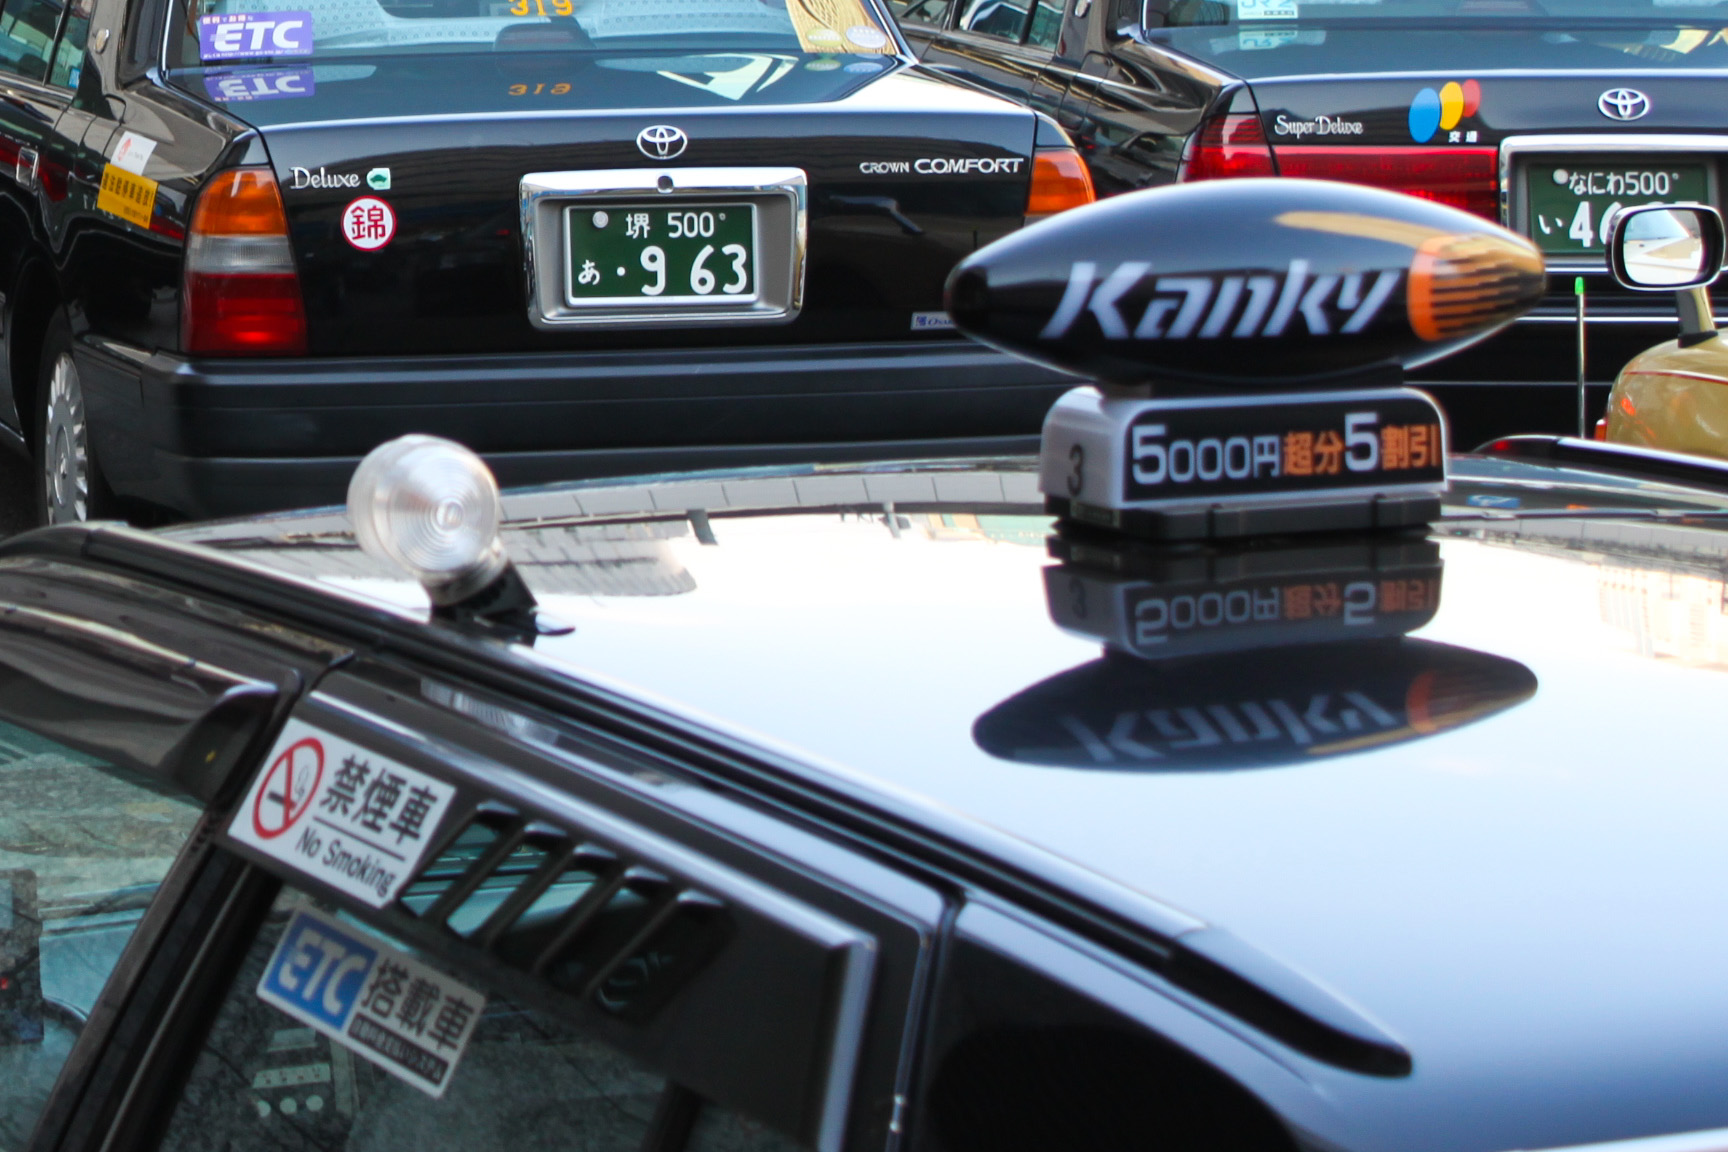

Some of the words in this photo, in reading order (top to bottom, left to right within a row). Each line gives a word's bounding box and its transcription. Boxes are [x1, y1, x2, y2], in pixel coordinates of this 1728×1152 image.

[213, 20, 303, 52] ETC
[1274, 114, 1314, 140] Super
[1315, 116, 1363, 137] Deluxe
[1448, 130, 1478, 143] 交通
[289, 167, 361, 189] Deluxe
[859, 161, 910, 174] CROWN
[914, 158, 1024, 175] COMFORT
[1569, 171, 1624, 196] なにわ
[1624, 171, 1669, 195] 500
[350, 204, 387, 241] 錦
[626, 212, 651, 239] 堺
[668, 211, 715, 238] 500
[1538, 214, 1563, 235] い
[578, 259, 600, 286] あ
[1040, 259, 1399, 339] Kanky
[1133, 411, 1441, 485] 5000円超分5割引
[1067, 443, 1084, 497] 3
[319, 754, 439, 846] 禁煙車
[295, 826, 319, 860] No
[322, 838, 398, 899] Smoking
[278, 928, 368, 1017] ETC
[362, 956, 474, 1054] 搭載車
